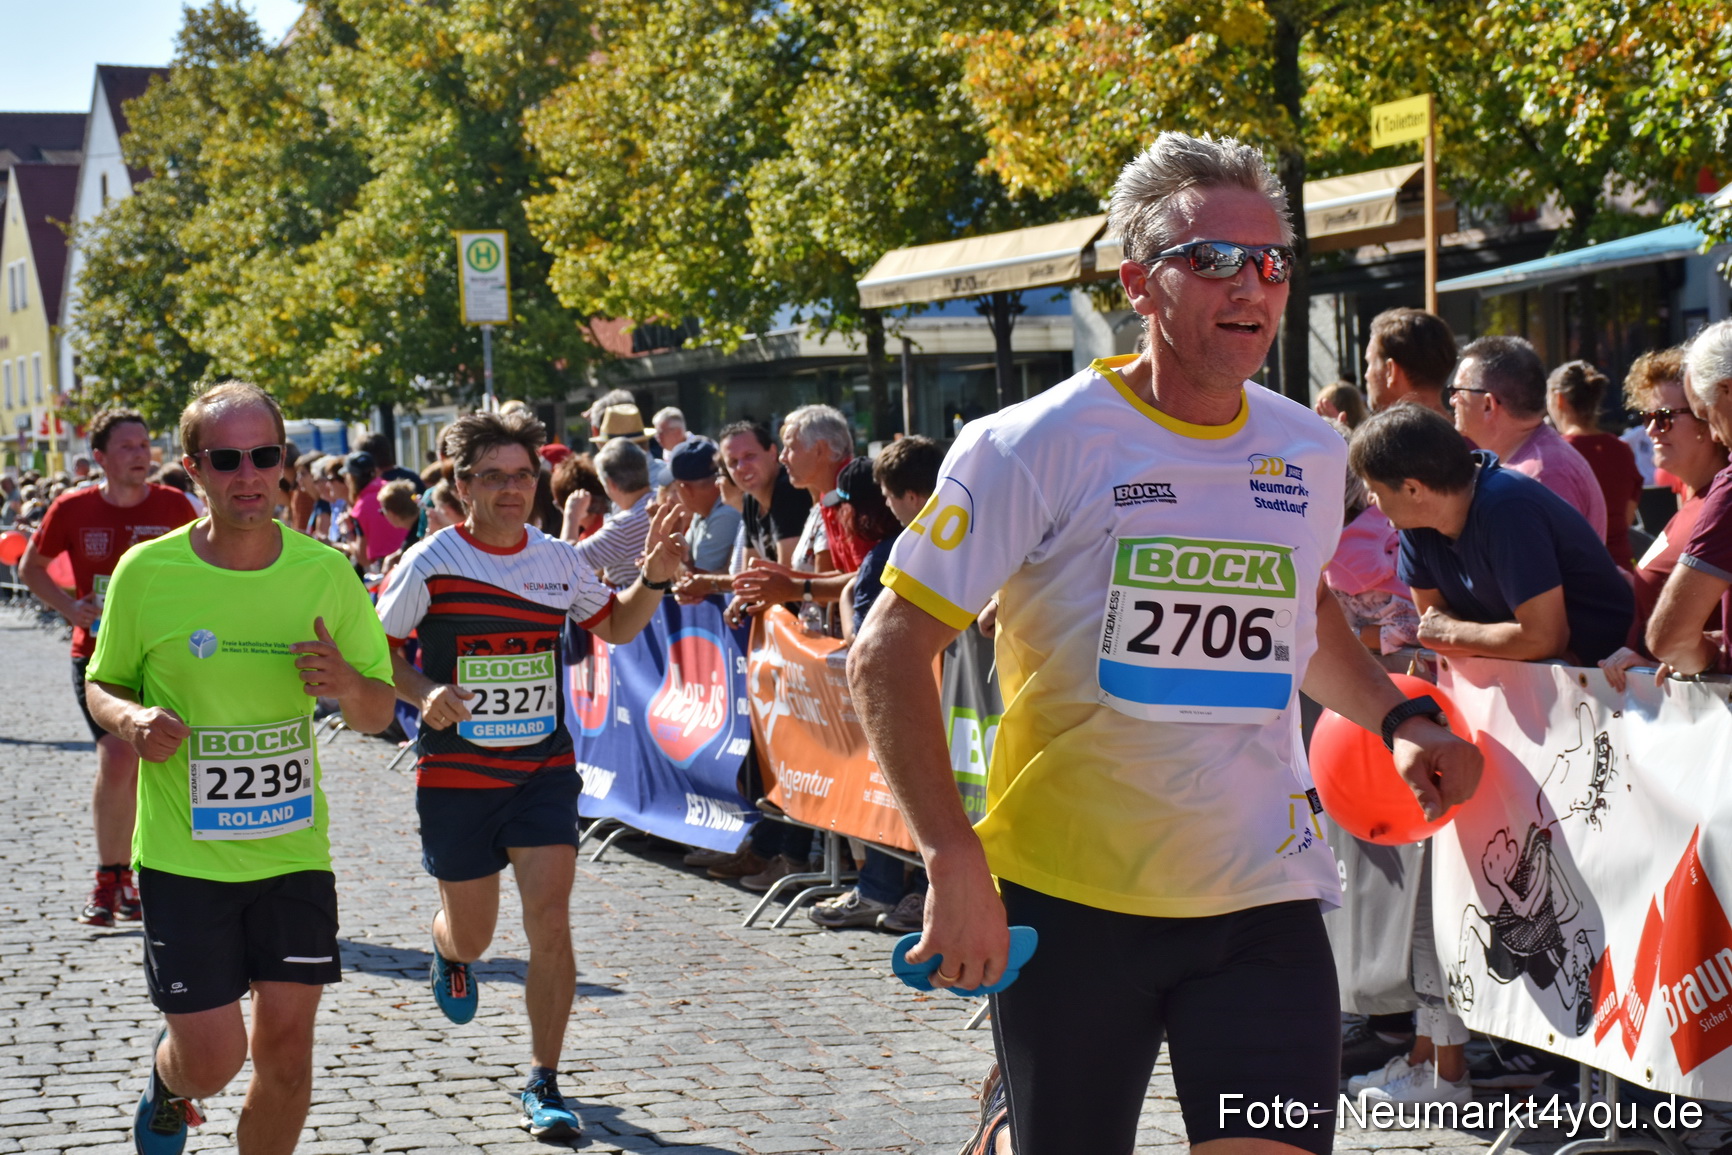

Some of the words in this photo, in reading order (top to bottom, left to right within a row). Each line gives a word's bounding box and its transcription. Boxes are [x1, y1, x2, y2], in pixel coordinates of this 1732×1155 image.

[1383, 112, 1426, 132] Toiletten
[475, 245, 492, 265] H
[1253, 457, 1284, 476] 20
[1114, 483, 1175, 500] BOCK
[1254, 497, 1309, 517] Stadtlauf
[1132, 546, 1283, 589] BOCK
[523, 582, 562, 591] NEUMARKT
[1126, 600, 1275, 661] 2706
[238, 640, 272, 648] katholische
[467, 657, 548, 680] BOCK
[471, 685, 546, 716] 2327
[652, 662, 725, 737] hervis
[200, 723, 302, 755] BOCK
[472, 720, 545, 737] GERHARD
[206, 759, 302, 800] 2239
[777, 760, 834, 798] Agentur
[218, 805, 294, 827] ROLAND
[1660, 947, 1732, 1038] Braun
[1699, 1009, 1728, 1033] Sicher
